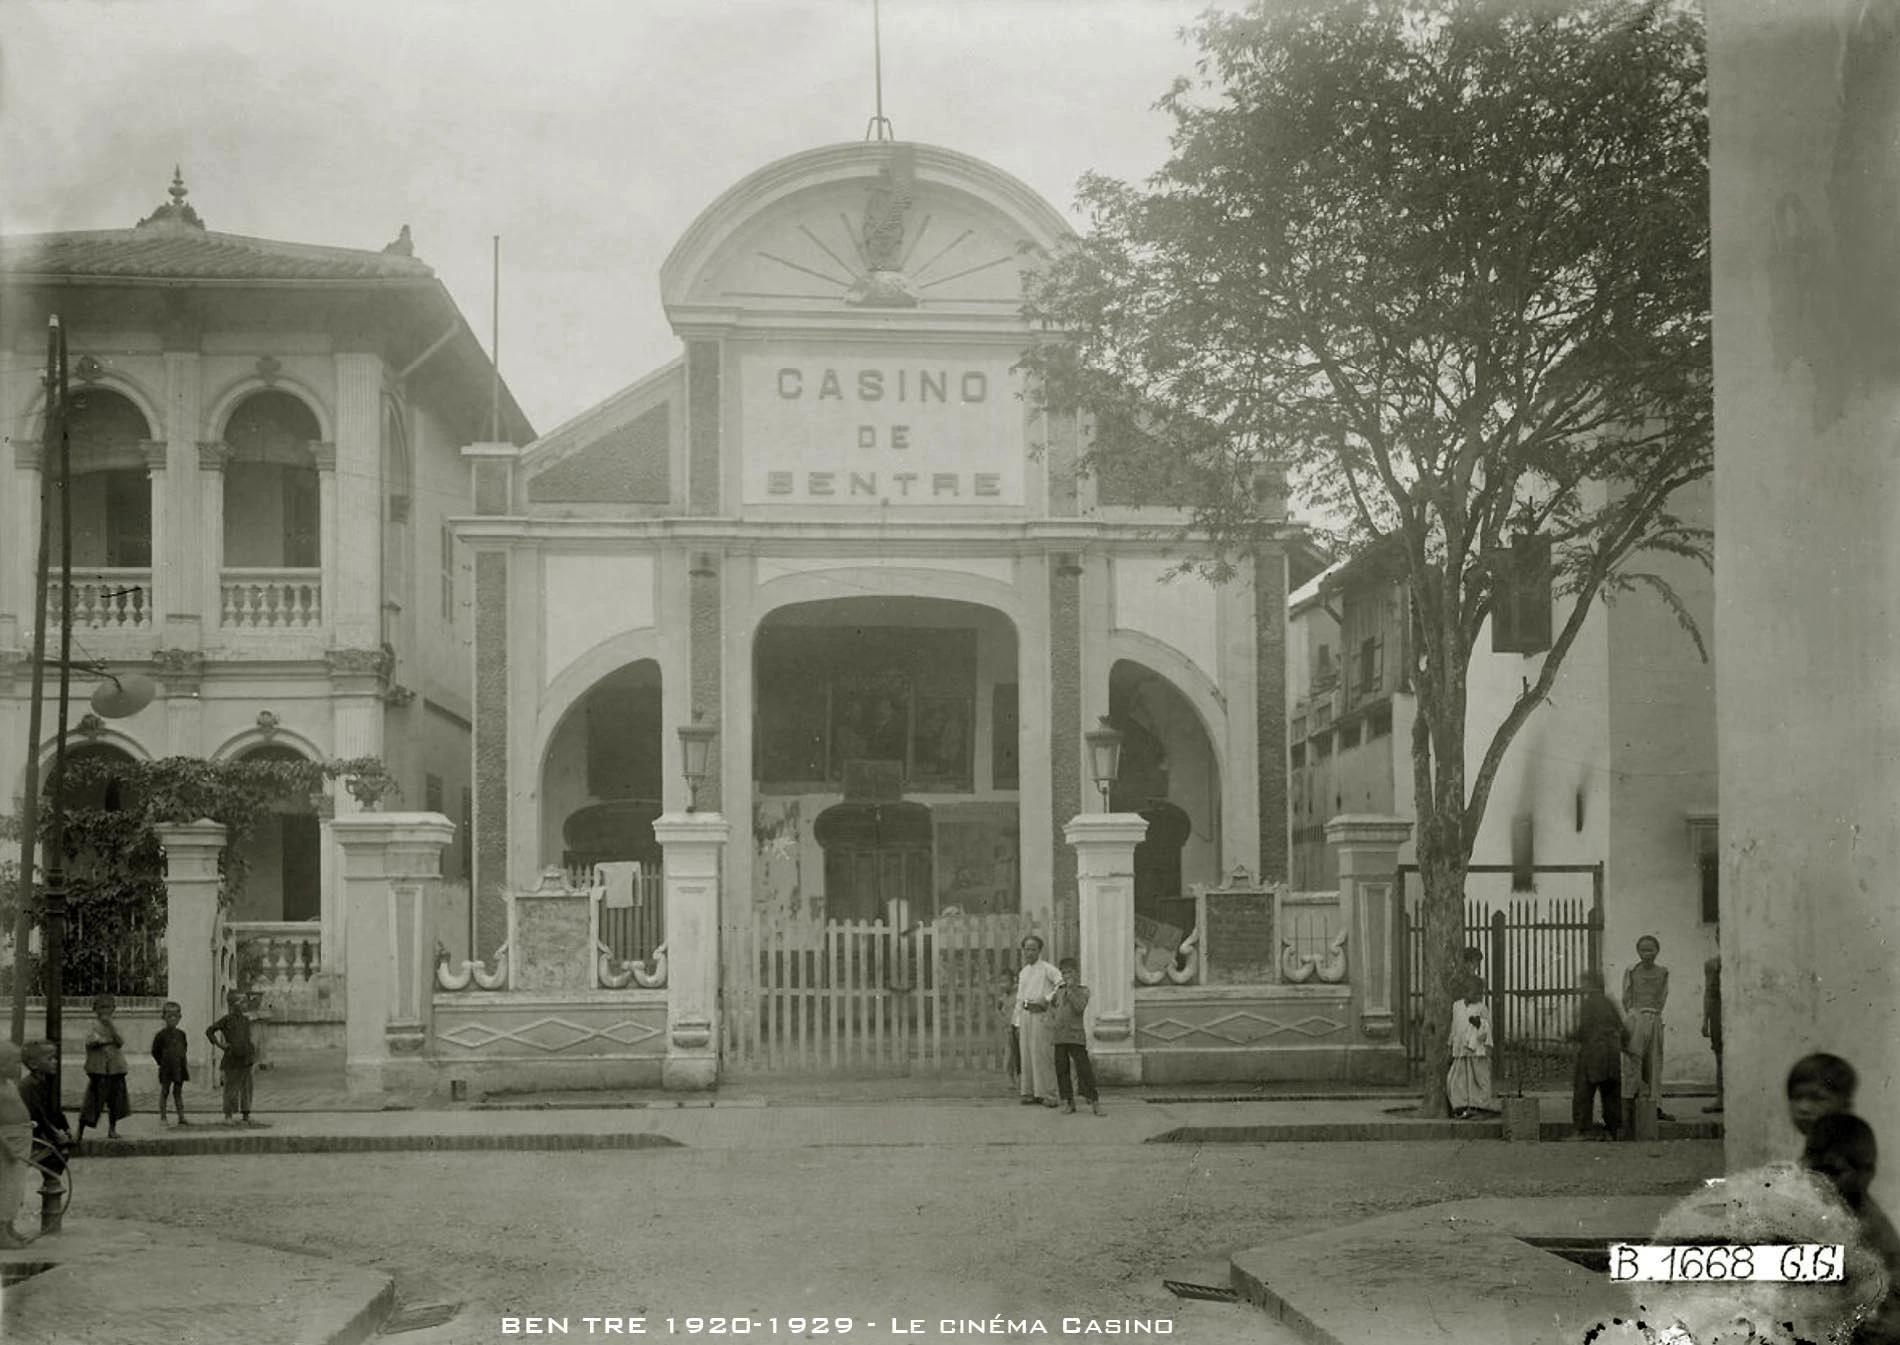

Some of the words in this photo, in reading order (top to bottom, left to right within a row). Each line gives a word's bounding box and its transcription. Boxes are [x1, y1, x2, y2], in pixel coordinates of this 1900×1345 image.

[777, 367, 989, 404] CASINO
[857, 424, 911, 450] DE
[767, 471, 1001, 497] BENTRE
